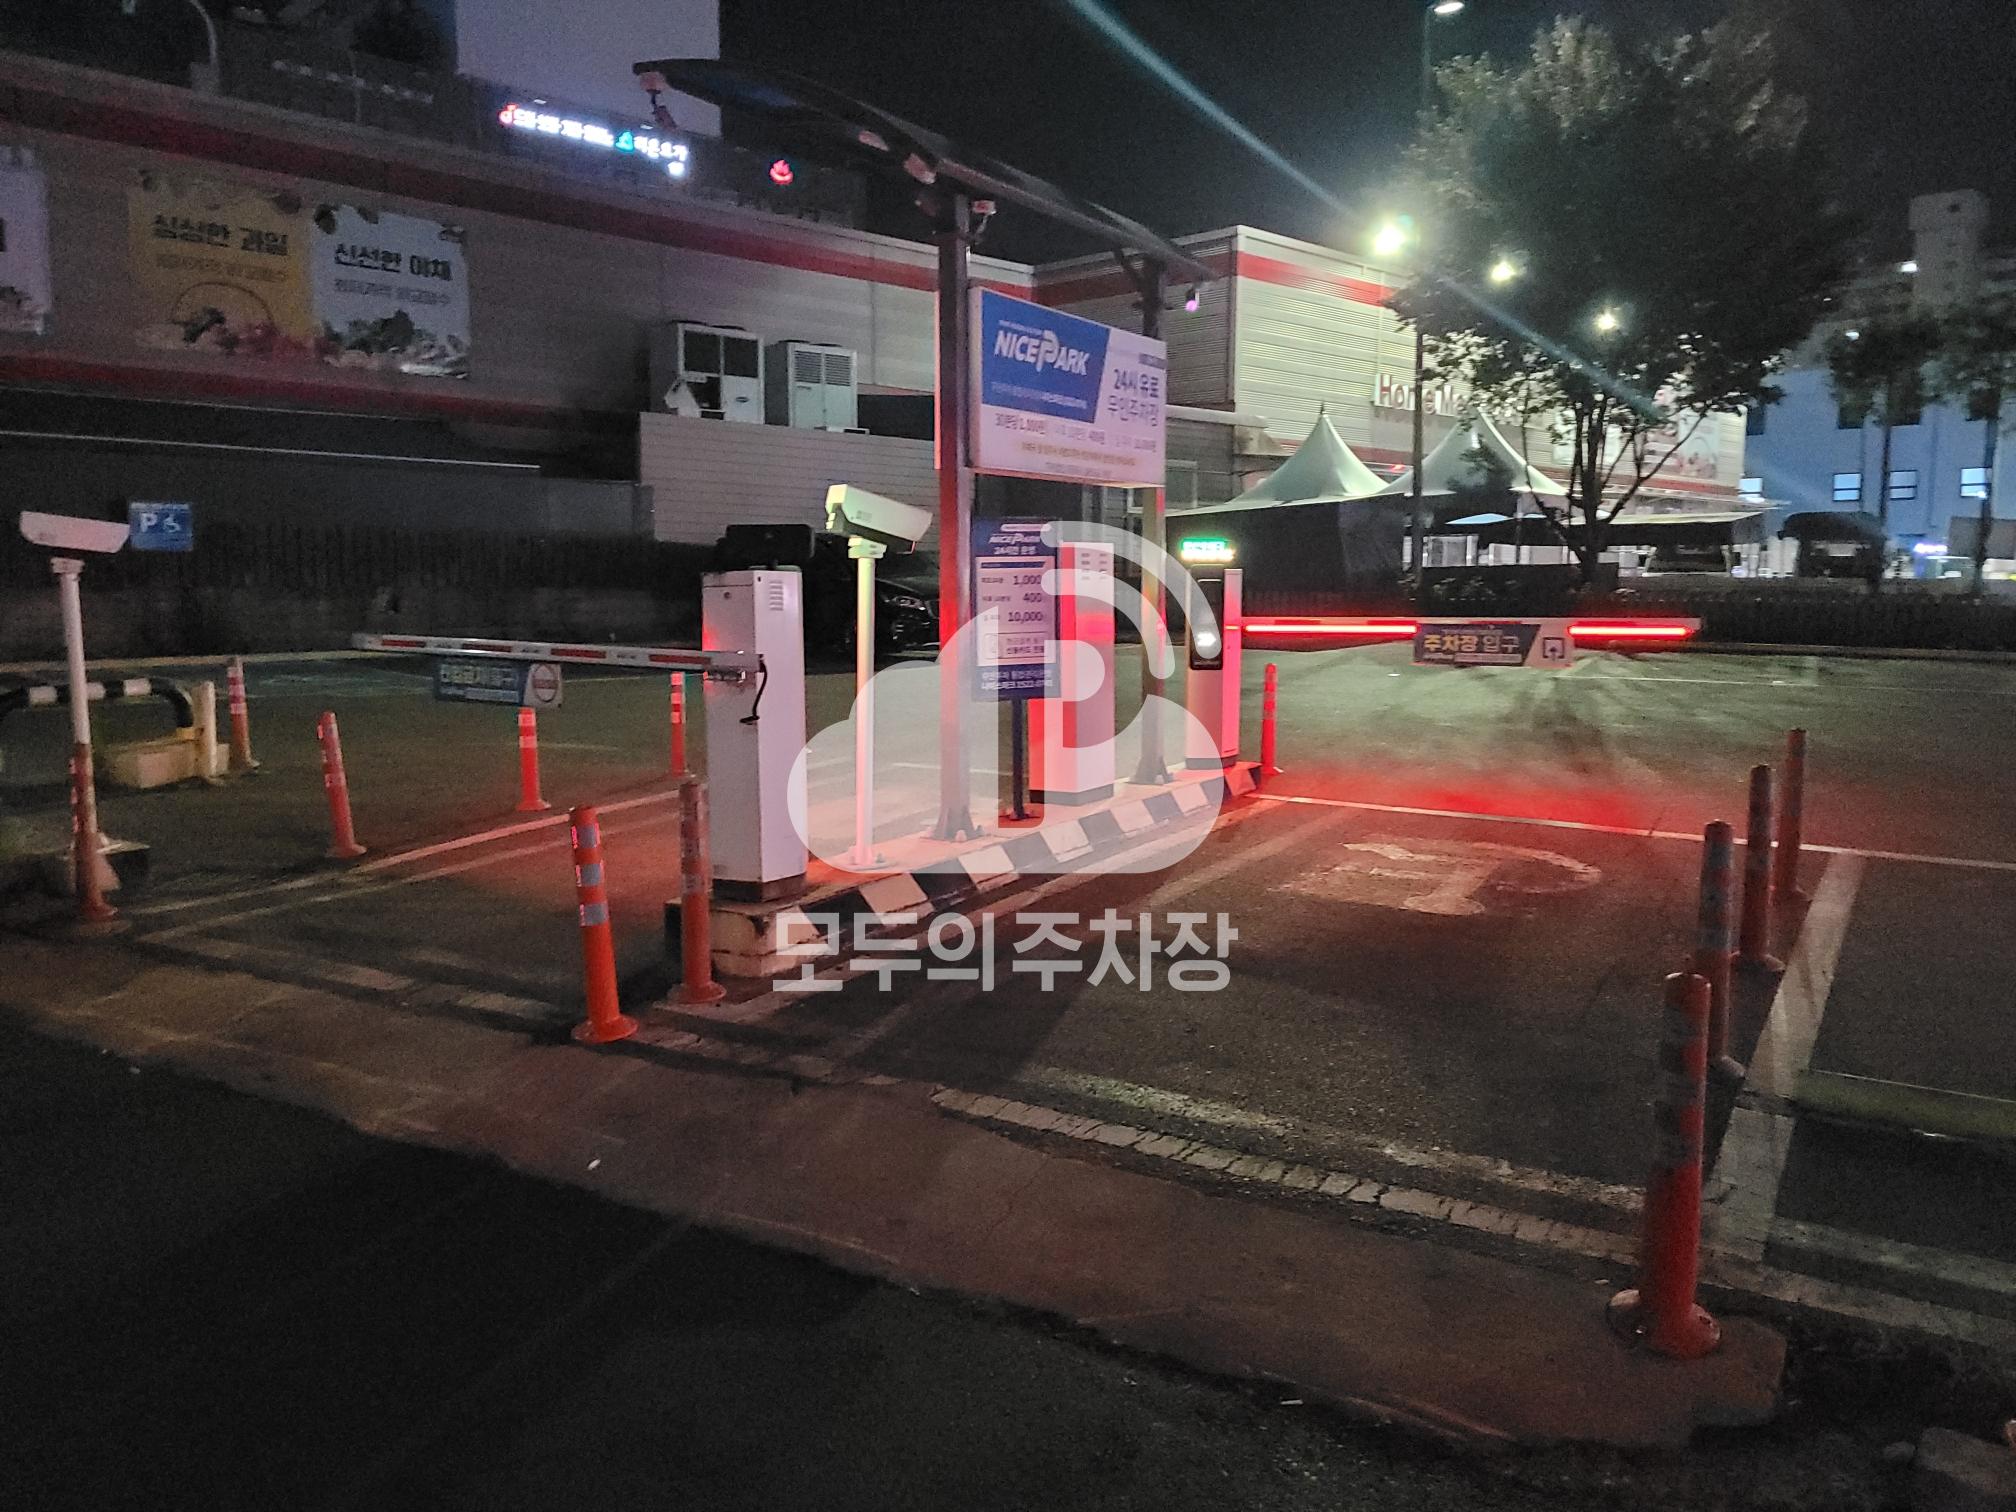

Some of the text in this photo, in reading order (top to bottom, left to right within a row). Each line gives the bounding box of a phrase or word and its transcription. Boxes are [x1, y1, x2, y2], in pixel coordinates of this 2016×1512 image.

[335, 243, 402, 274] 신선한
[994, 330, 1090, 377] NICEPARK
[139, 512, 158, 533] P
[1013, 574, 1043, 587] 1,000
[1007, 611, 1044, 624] 10,000
[1423, 634, 1521, 653] 주차장 입구
